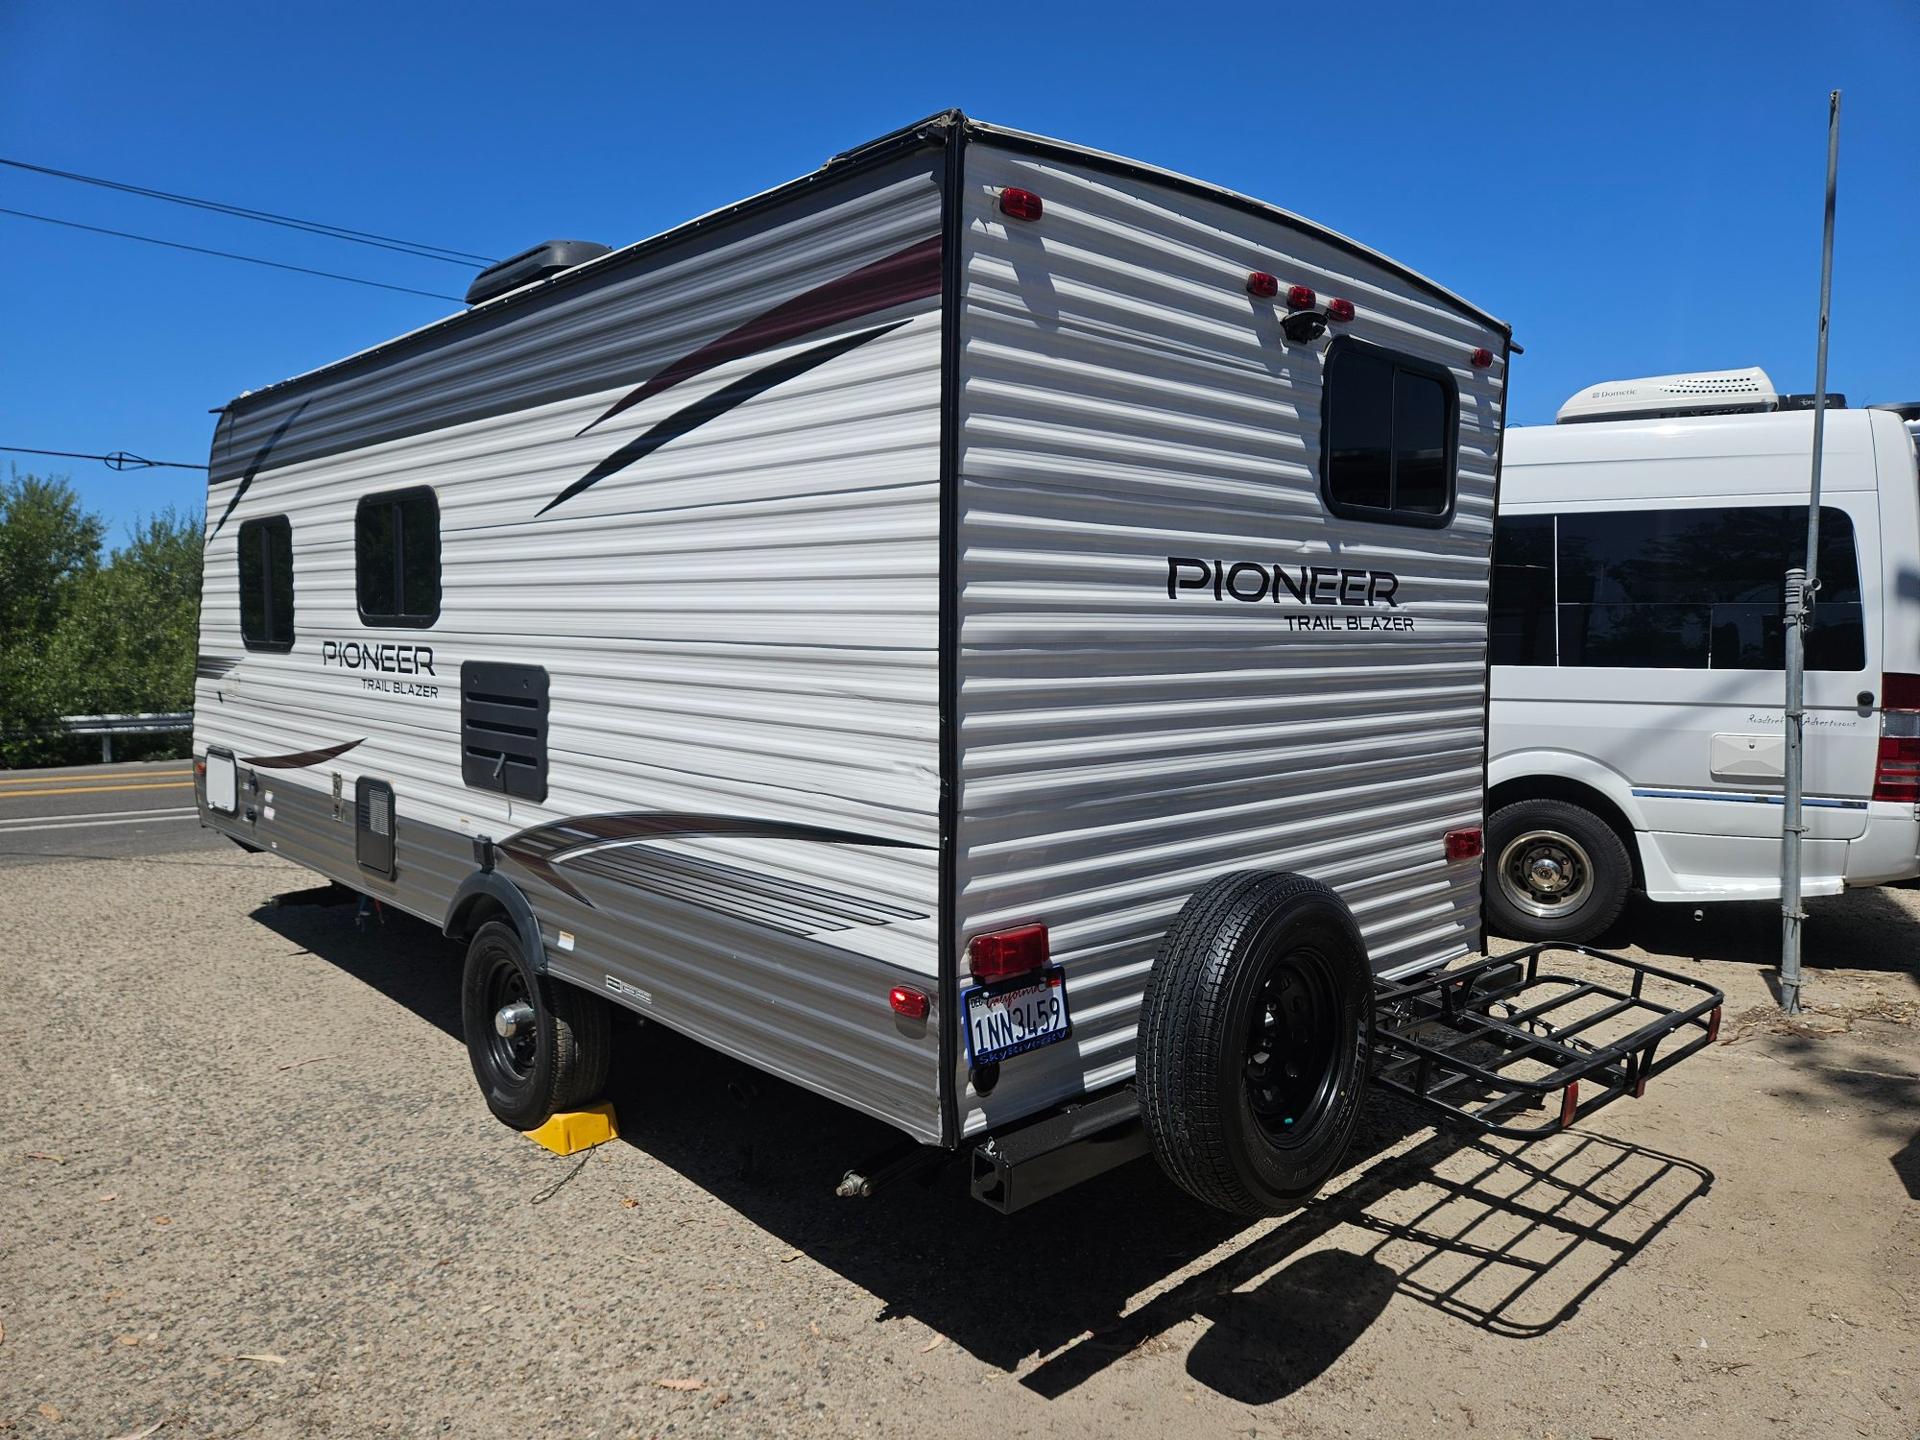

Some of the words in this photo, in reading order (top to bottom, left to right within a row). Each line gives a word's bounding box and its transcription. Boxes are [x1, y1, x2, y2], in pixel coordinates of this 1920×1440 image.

[1167, 556, 1399, 608] PIONEER
[1284, 615, 1342, 632] TRAIL
[1346, 615, 1414, 632] BLAZER
[322, 641, 436, 676] PIONEER
[361, 678, 390, 693] TRAIL
[393, 681, 439, 699] BLAZER
[975, 997, 1060, 1054] 1NN3459
